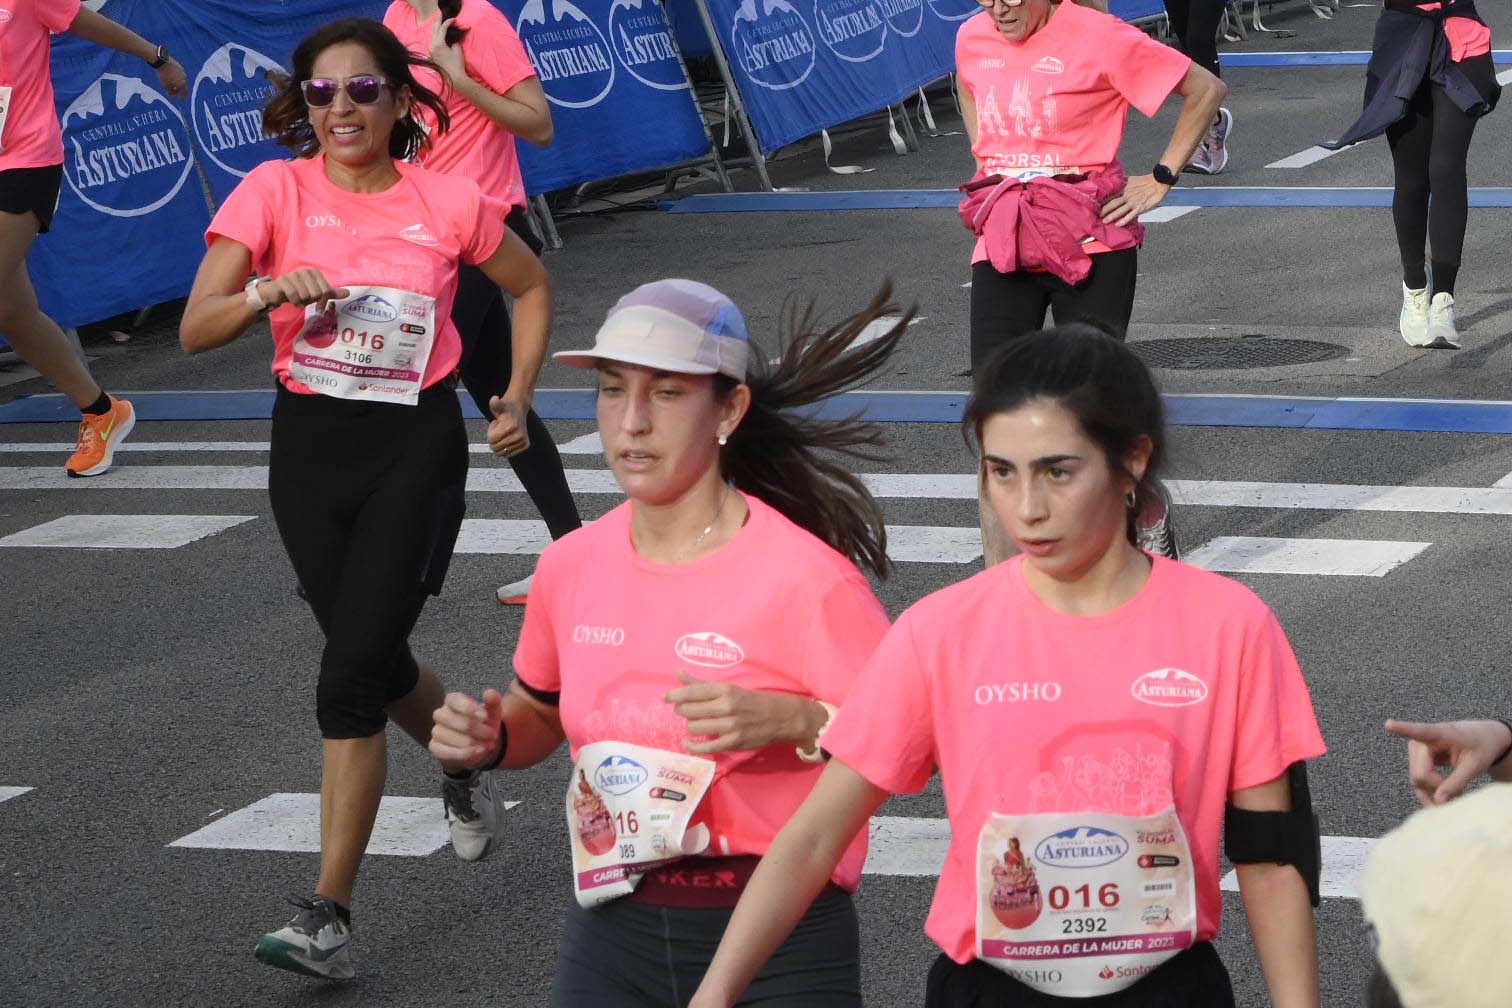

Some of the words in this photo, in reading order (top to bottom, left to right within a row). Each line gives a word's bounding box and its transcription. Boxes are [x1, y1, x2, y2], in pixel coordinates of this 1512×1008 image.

[534, 30, 561, 45] CENTRAL
[214, 92, 253, 107] CENTRAL
[82, 125, 125, 143] CENTRAL
[71, 128, 185, 189] ASTURIANA
[341, 328, 384, 350] 016
[305, 358, 340, 370] CARRERA
[344, 351, 372, 363] 3106
[369, 383, 408, 394] Santander
[573, 626, 624, 646] OYSHO
[975, 681, 1061, 705] OYSHO
[1138, 681, 1202, 699] ASTURIANA
[1137, 834, 1175, 845] SUMA
[1042, 843, 1122, 861] ASTURIANA
[1049, 883, 1120, 910] 016
[1062, 917, 1107, 934] 2392
[1003, 942, 1059, 956] CARRERA
[1062, 943, 1080, 954] DE
[1083, 942, 1098, 952] LA
[1101, 939, 1143, 951] MUJER
[1147, 935, 1175, 948] 2023
